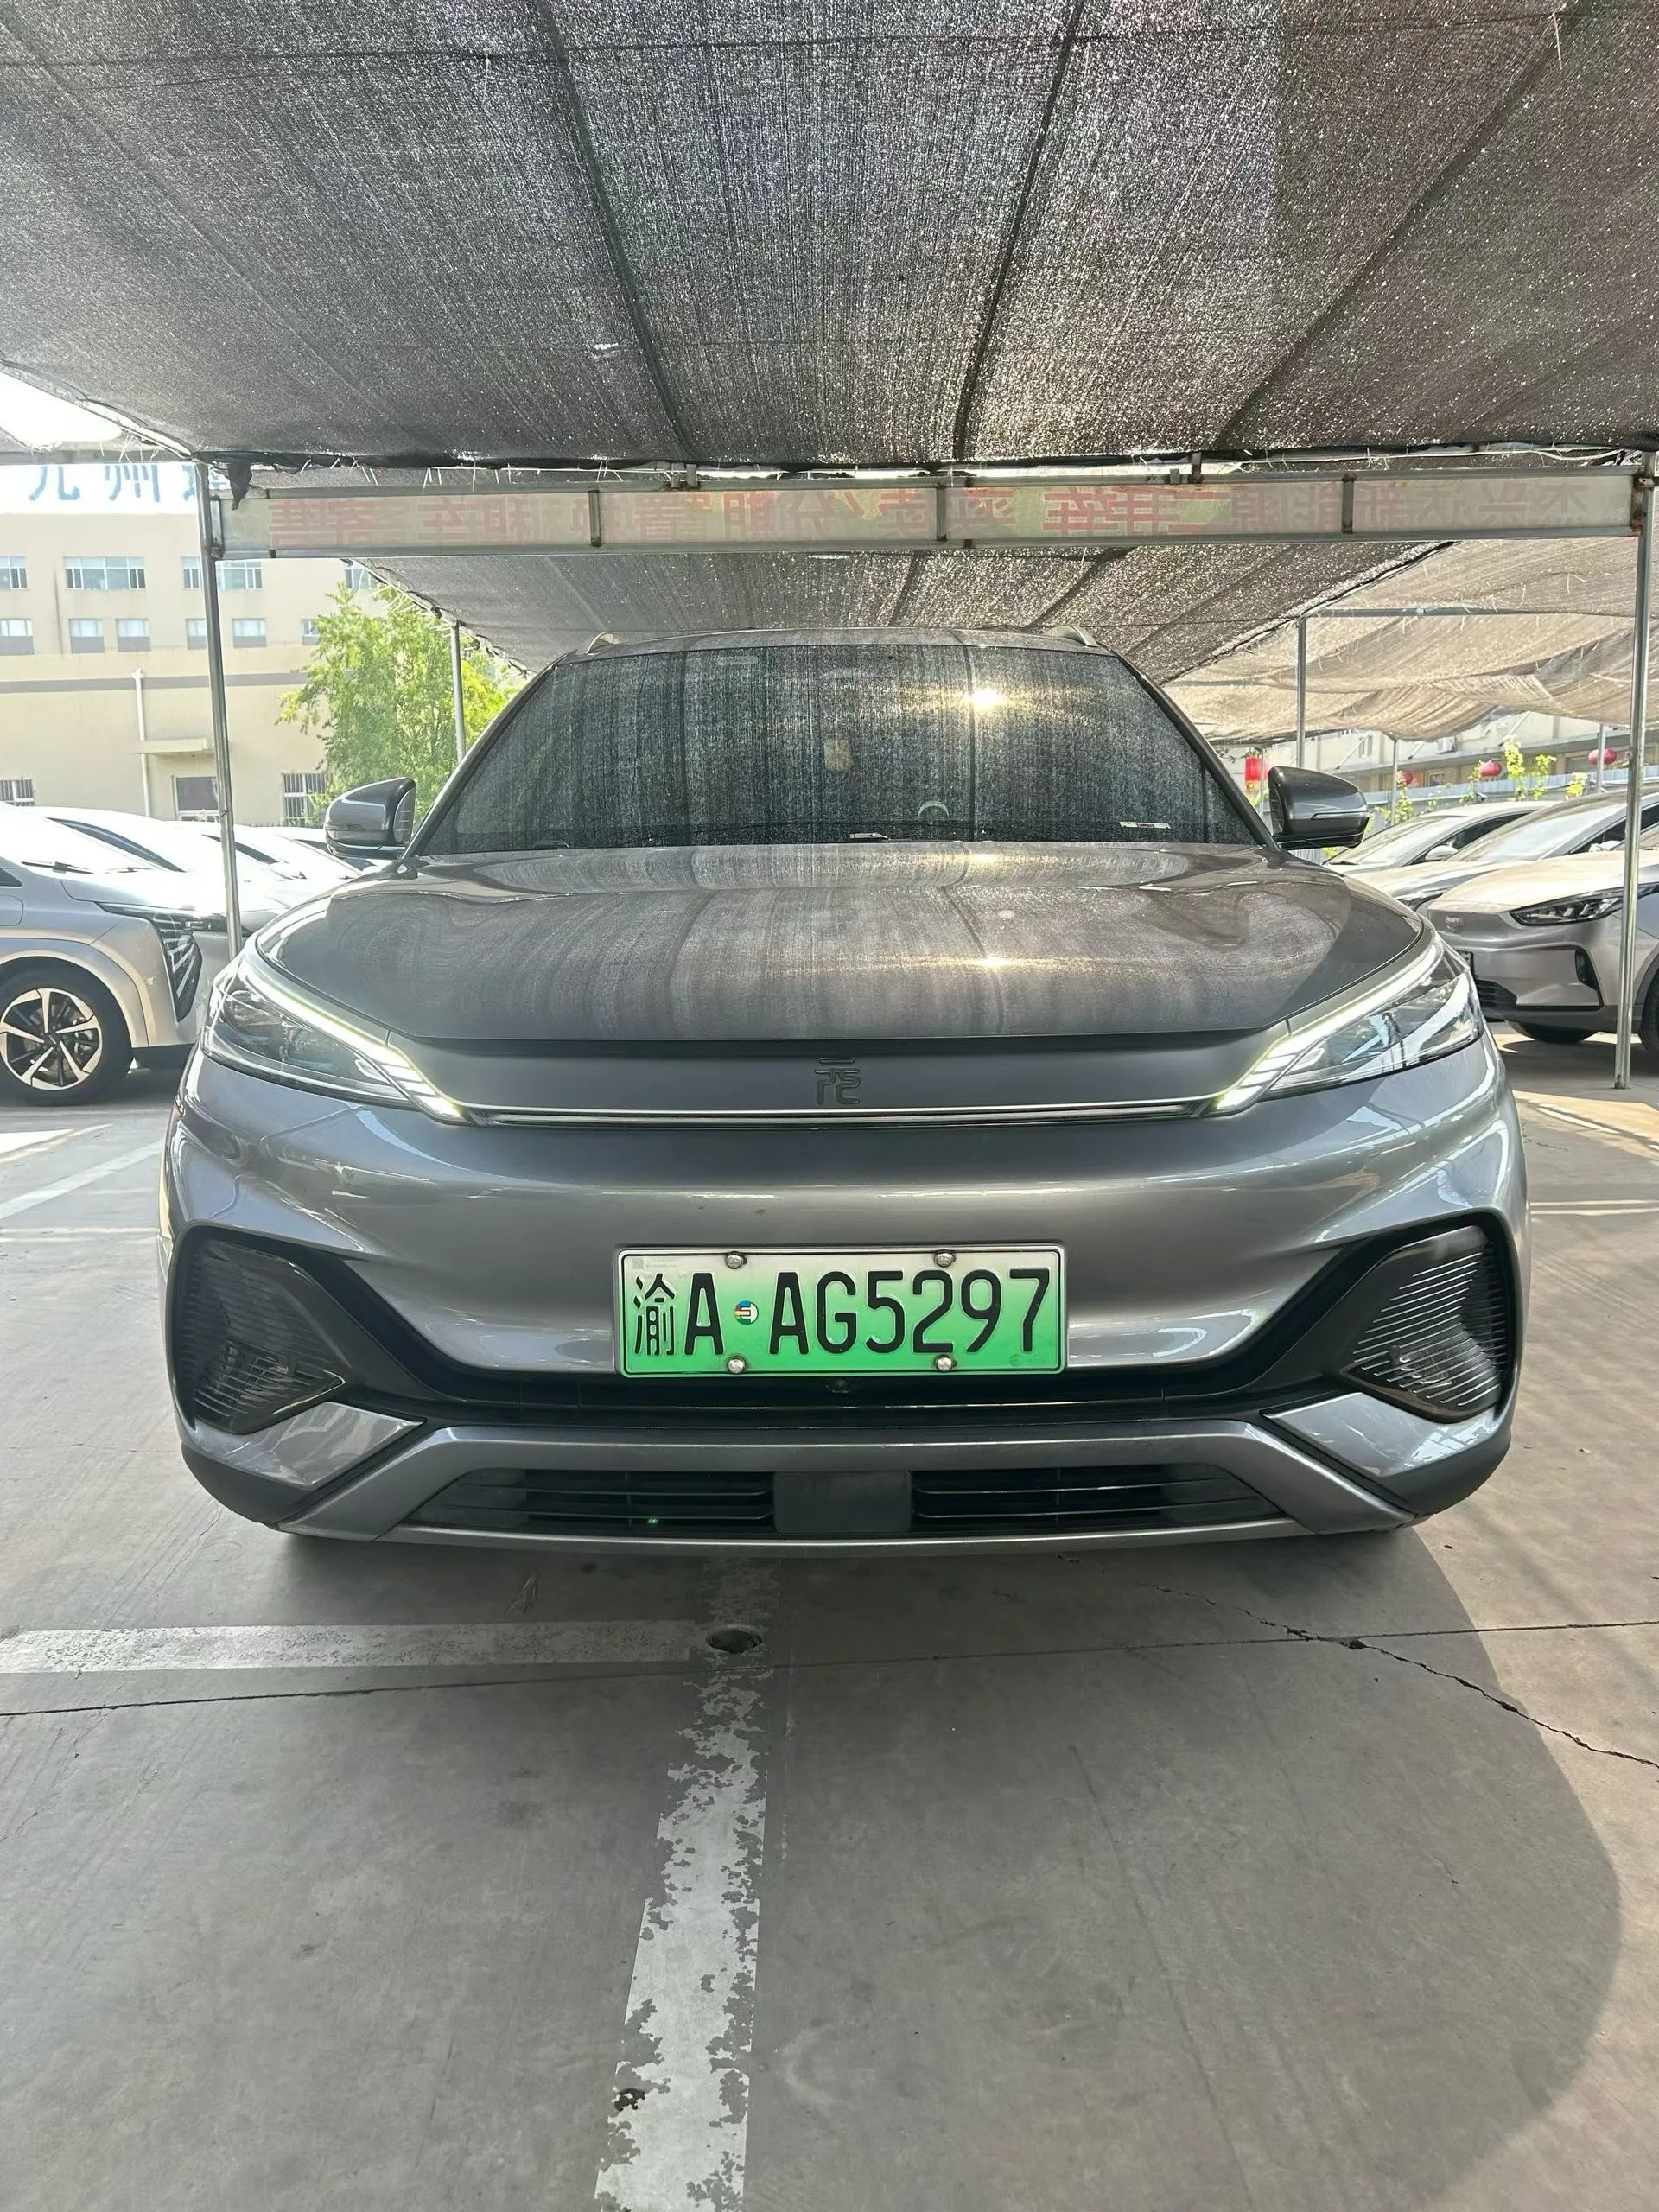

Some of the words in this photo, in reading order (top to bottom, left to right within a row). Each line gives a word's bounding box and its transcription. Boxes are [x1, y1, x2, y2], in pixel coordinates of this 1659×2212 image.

[29, 465, 197, 502] 九州
[633, 1272, 724, 1357] 渝A
[769, 1269, 1050, 1356] AG5297
